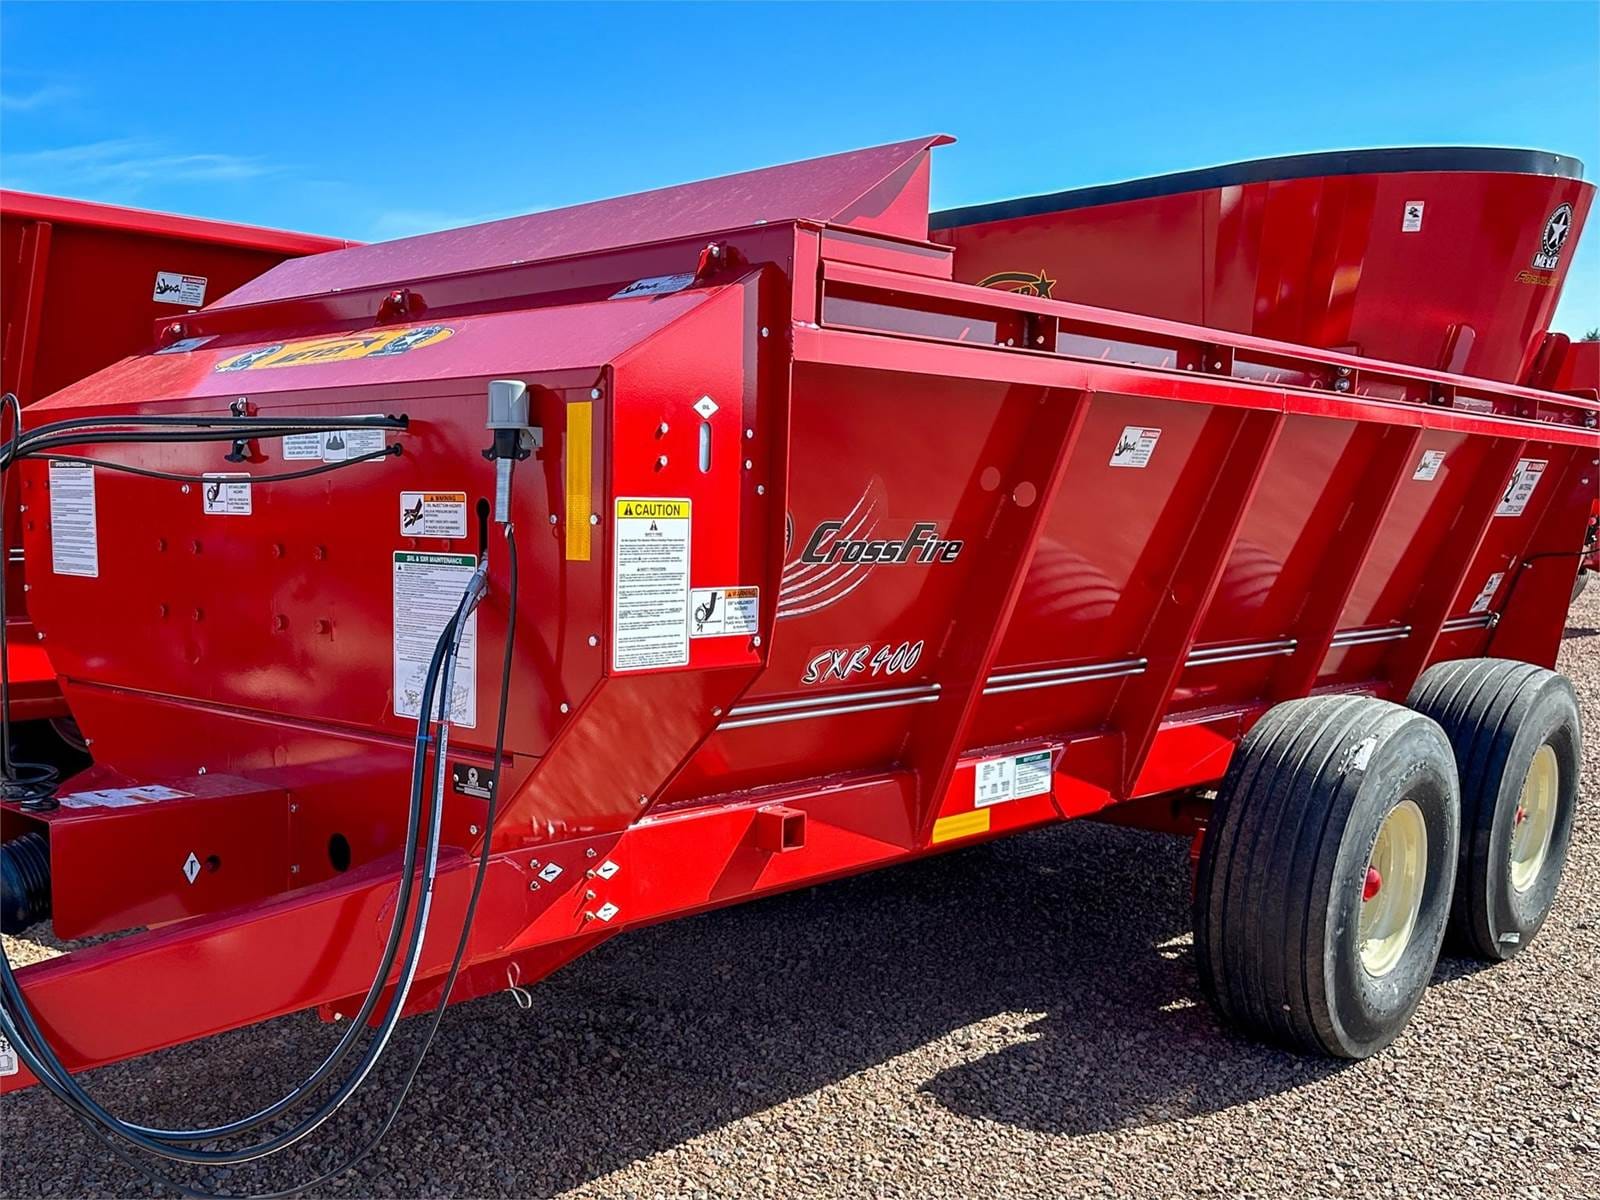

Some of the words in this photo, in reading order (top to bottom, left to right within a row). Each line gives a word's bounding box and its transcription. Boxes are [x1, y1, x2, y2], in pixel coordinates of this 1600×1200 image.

[634, 503, 681, 516] CAUTION
[801, 520, 964, 564] CrossFire
[429, 556, 463, 565] MAINTENANCE
[801, 645, 871, 683] SXR
[870, 639, 924, 677] 400
